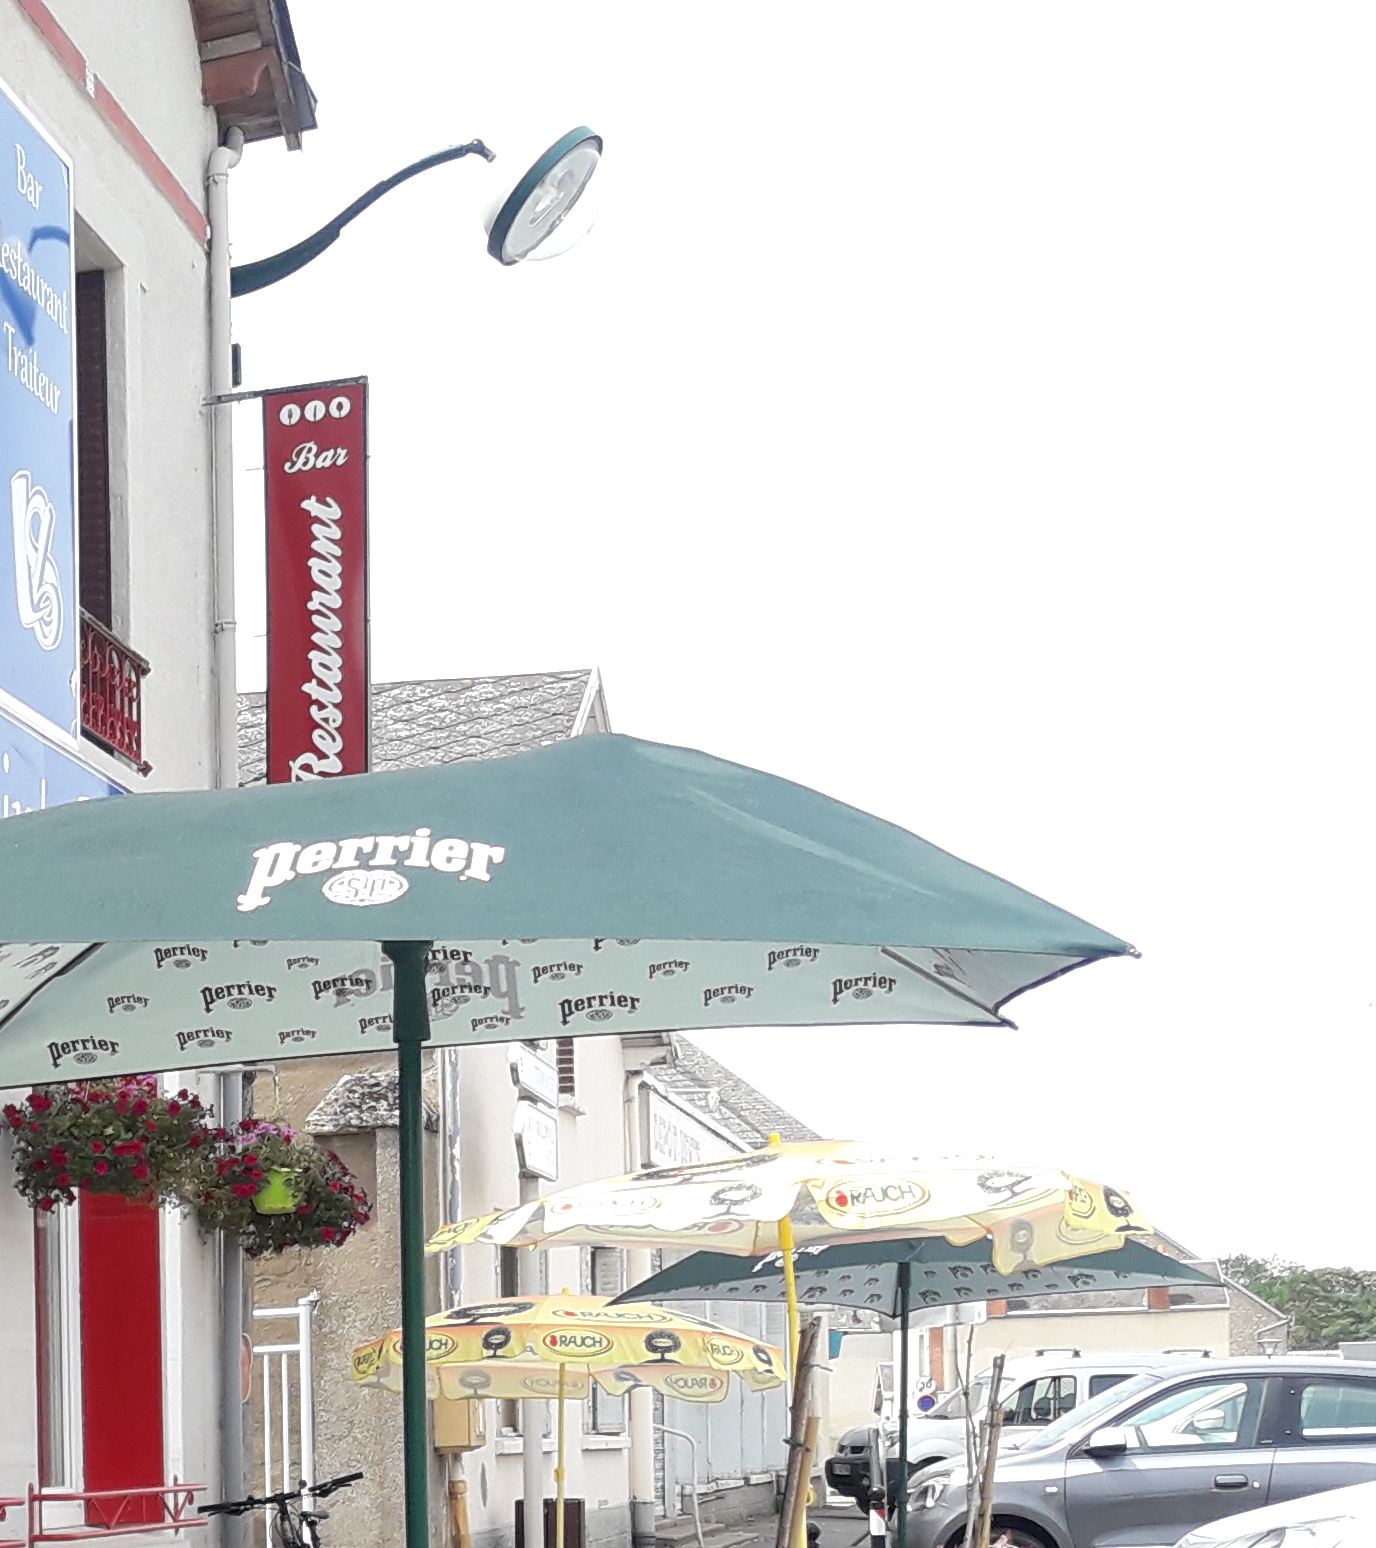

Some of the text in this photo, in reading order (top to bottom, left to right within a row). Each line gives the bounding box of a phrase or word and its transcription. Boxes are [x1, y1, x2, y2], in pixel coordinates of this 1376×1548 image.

[14, 142, 44, 210] Bar
[3, 321, 62, 415] Traiteur
[283, 441, 349, 473] Bar
[289, 496, 343, 783] Restaurant
[236, 827, 507, 913] perrier
[200, 981, 277, 1012] perrier
[831, 972, 897, 1004] perrier
[559, 991, 641, 1026] perrier
[47, 1036, 120, 1068] perrier
[175, 1027, 233, 1051] perrier
[850, 1184, 916, 1207] RAUCH
[559, 1336, 603, 1349] RAUCH
